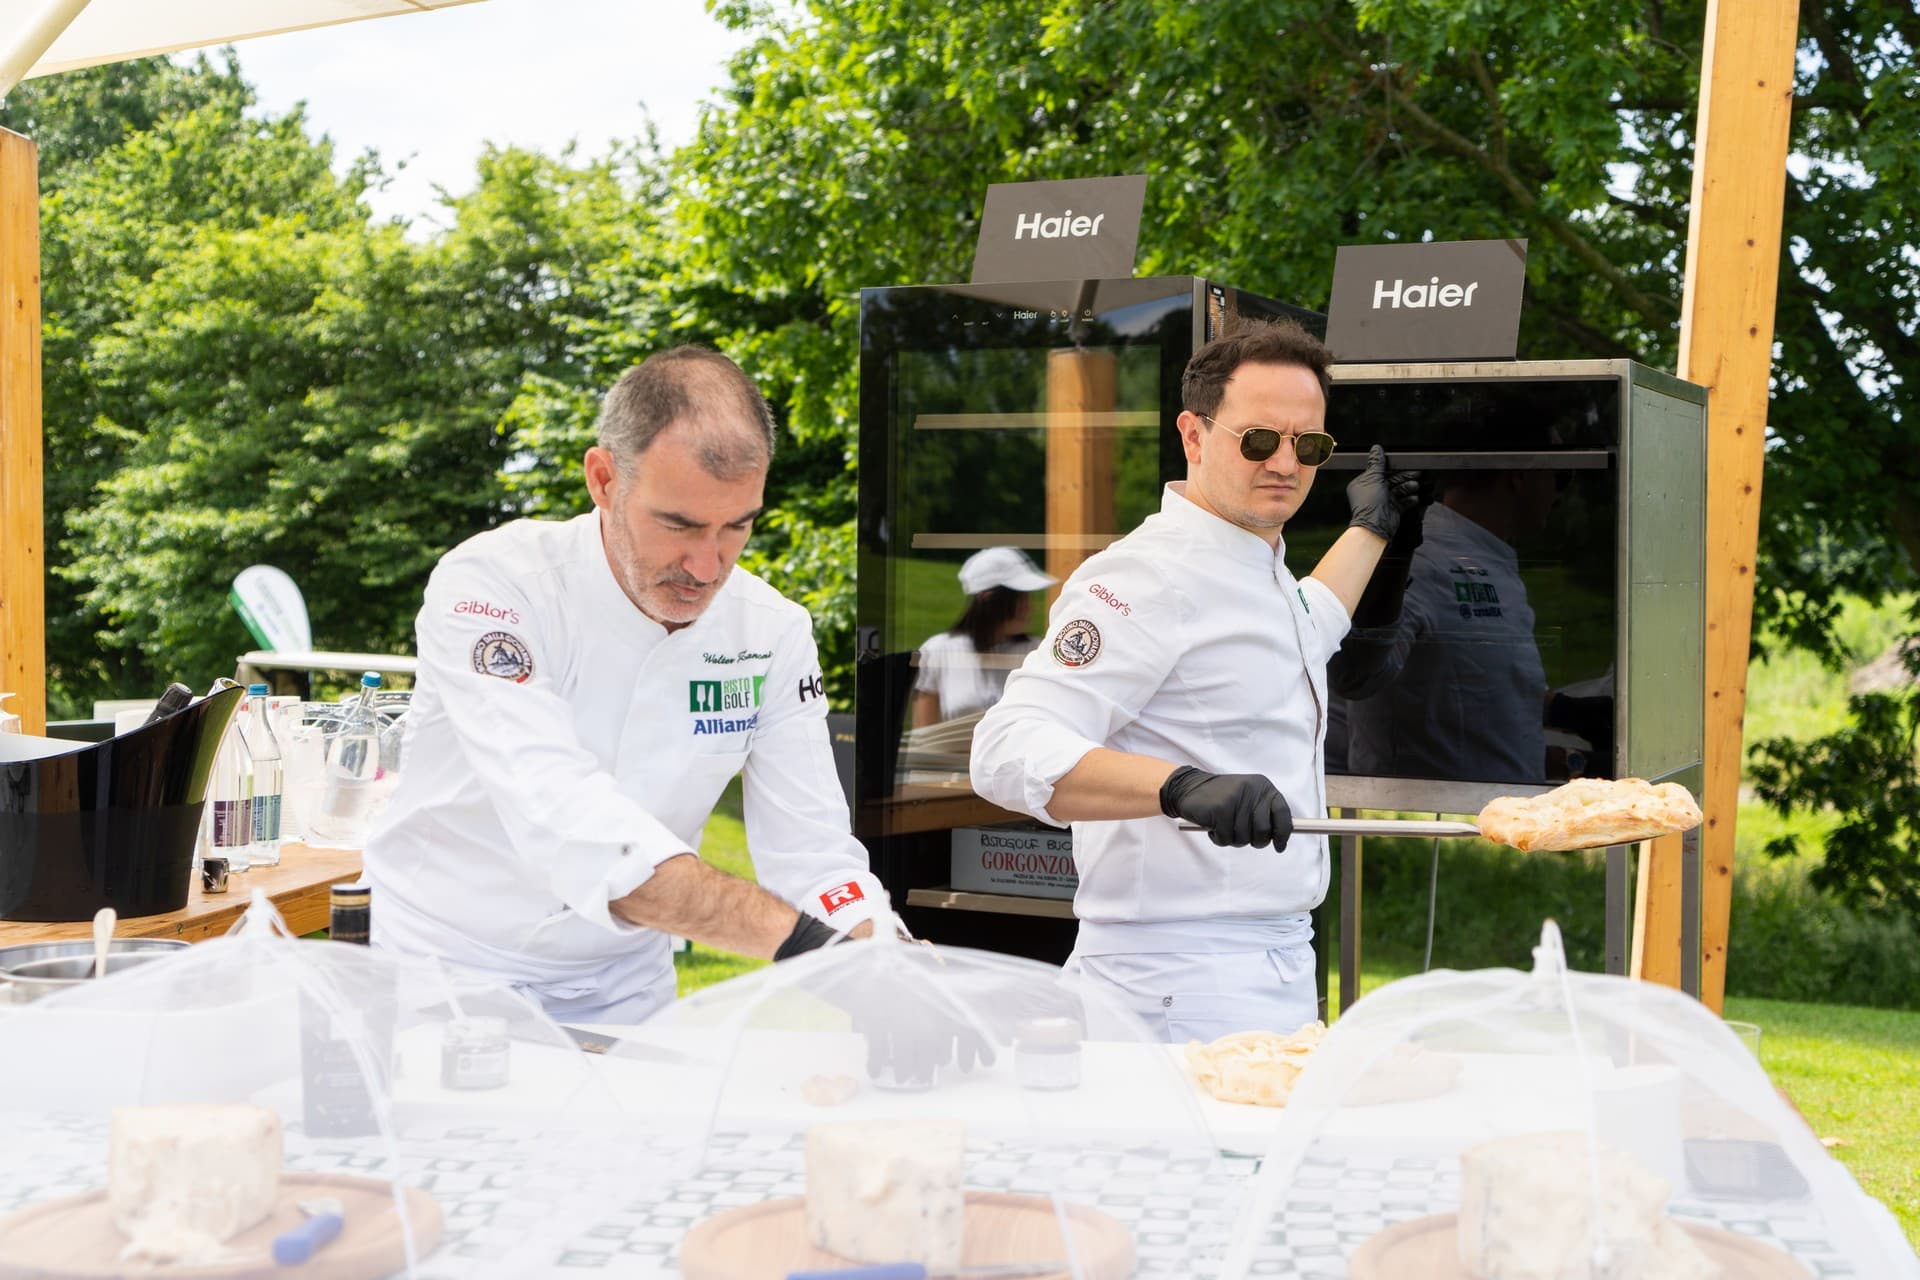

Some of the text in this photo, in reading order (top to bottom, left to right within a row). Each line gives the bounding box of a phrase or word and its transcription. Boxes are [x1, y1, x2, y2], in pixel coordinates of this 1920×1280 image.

[1015, 209, 1104, 240] Haier
[1372, 276, 1478, 309] Haier
[1013, 310, 1039, 320] Haier
[1089, 583, 1131, 616] Giblor's
[454, 601, 520, 625] Giblor's
[723, 677, 750, 694] RISTO
[724, 691, 751, 710] GOLF
[1047, 839, 1073, 851] BUC
